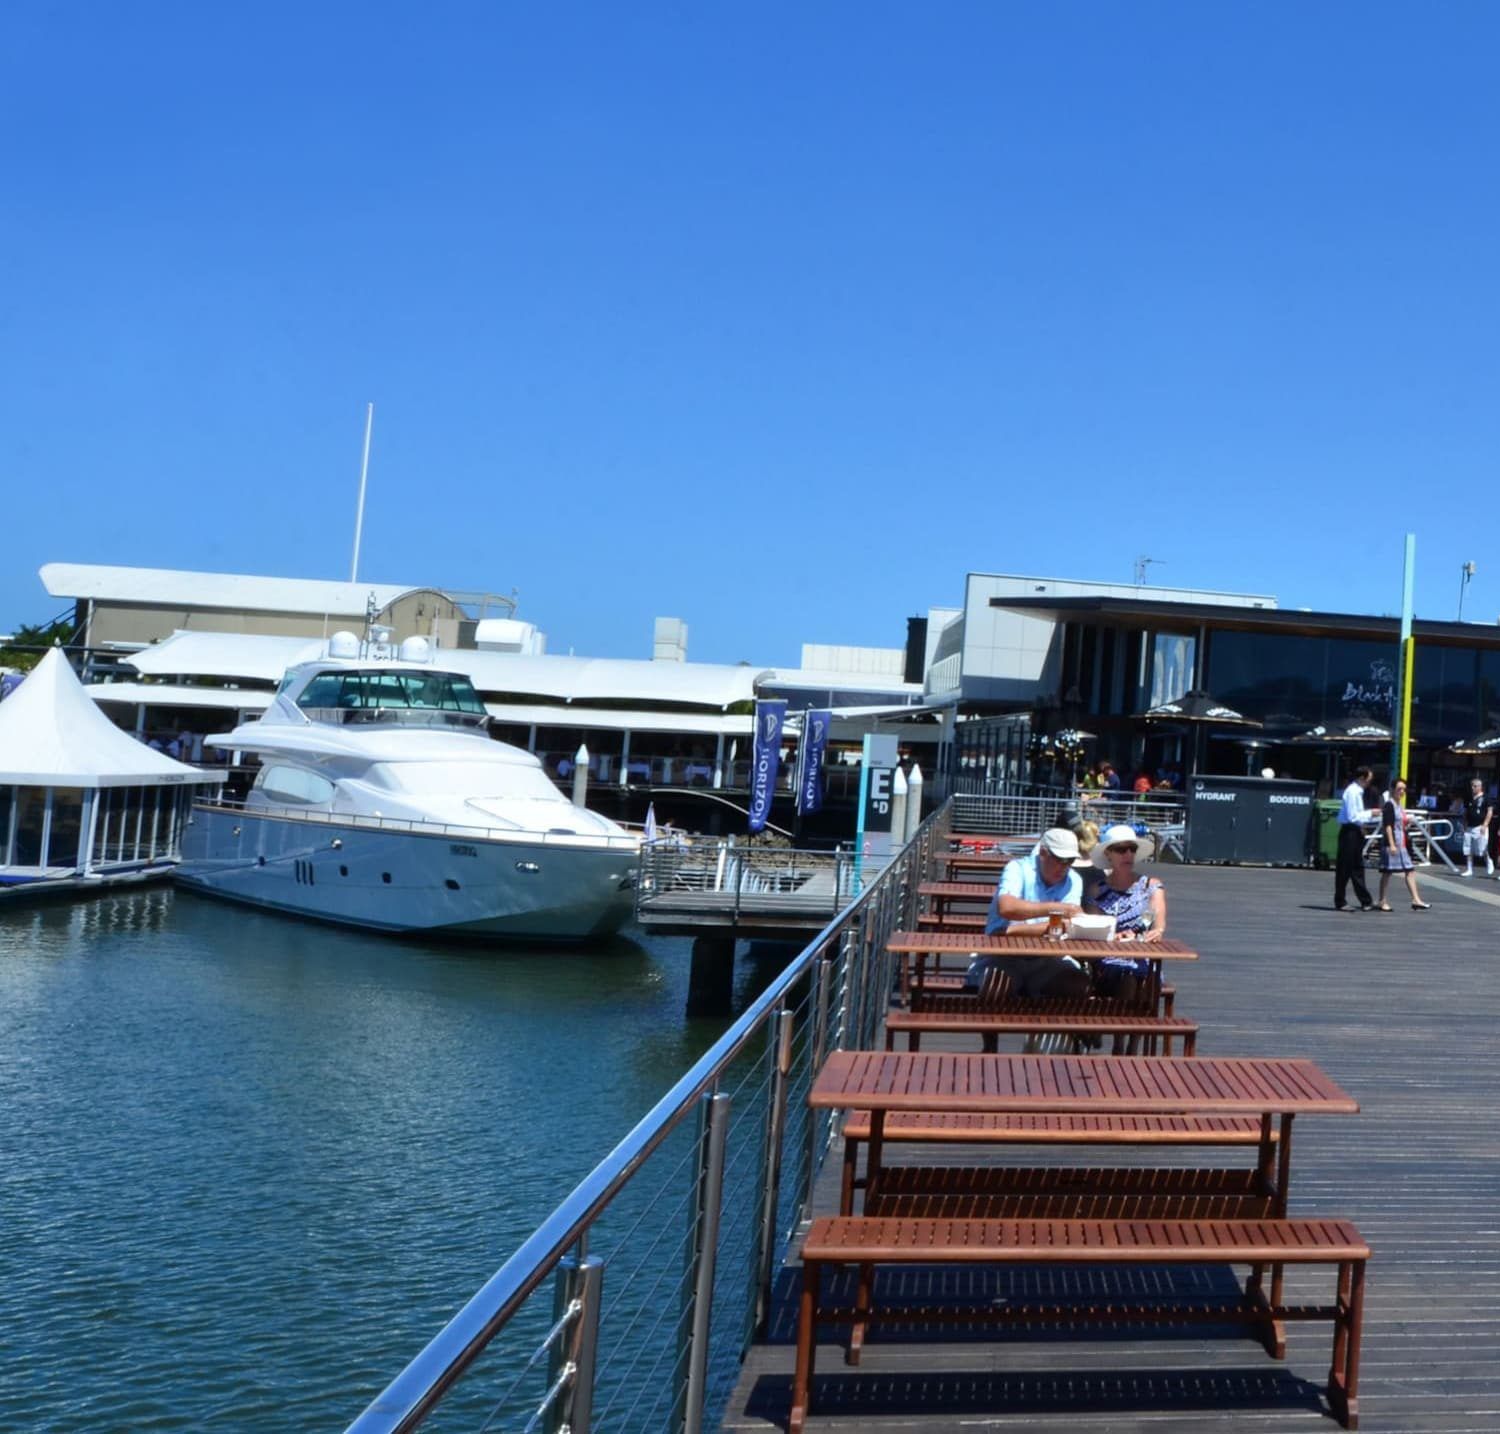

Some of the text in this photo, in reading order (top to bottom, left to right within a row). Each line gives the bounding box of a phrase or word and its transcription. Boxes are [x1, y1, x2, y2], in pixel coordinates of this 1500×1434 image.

[871, 769, 890, 799] E
[1195, 792, 1237, 802] HYDRANT
[1269, 795, 1310, 805] BOOSTER
